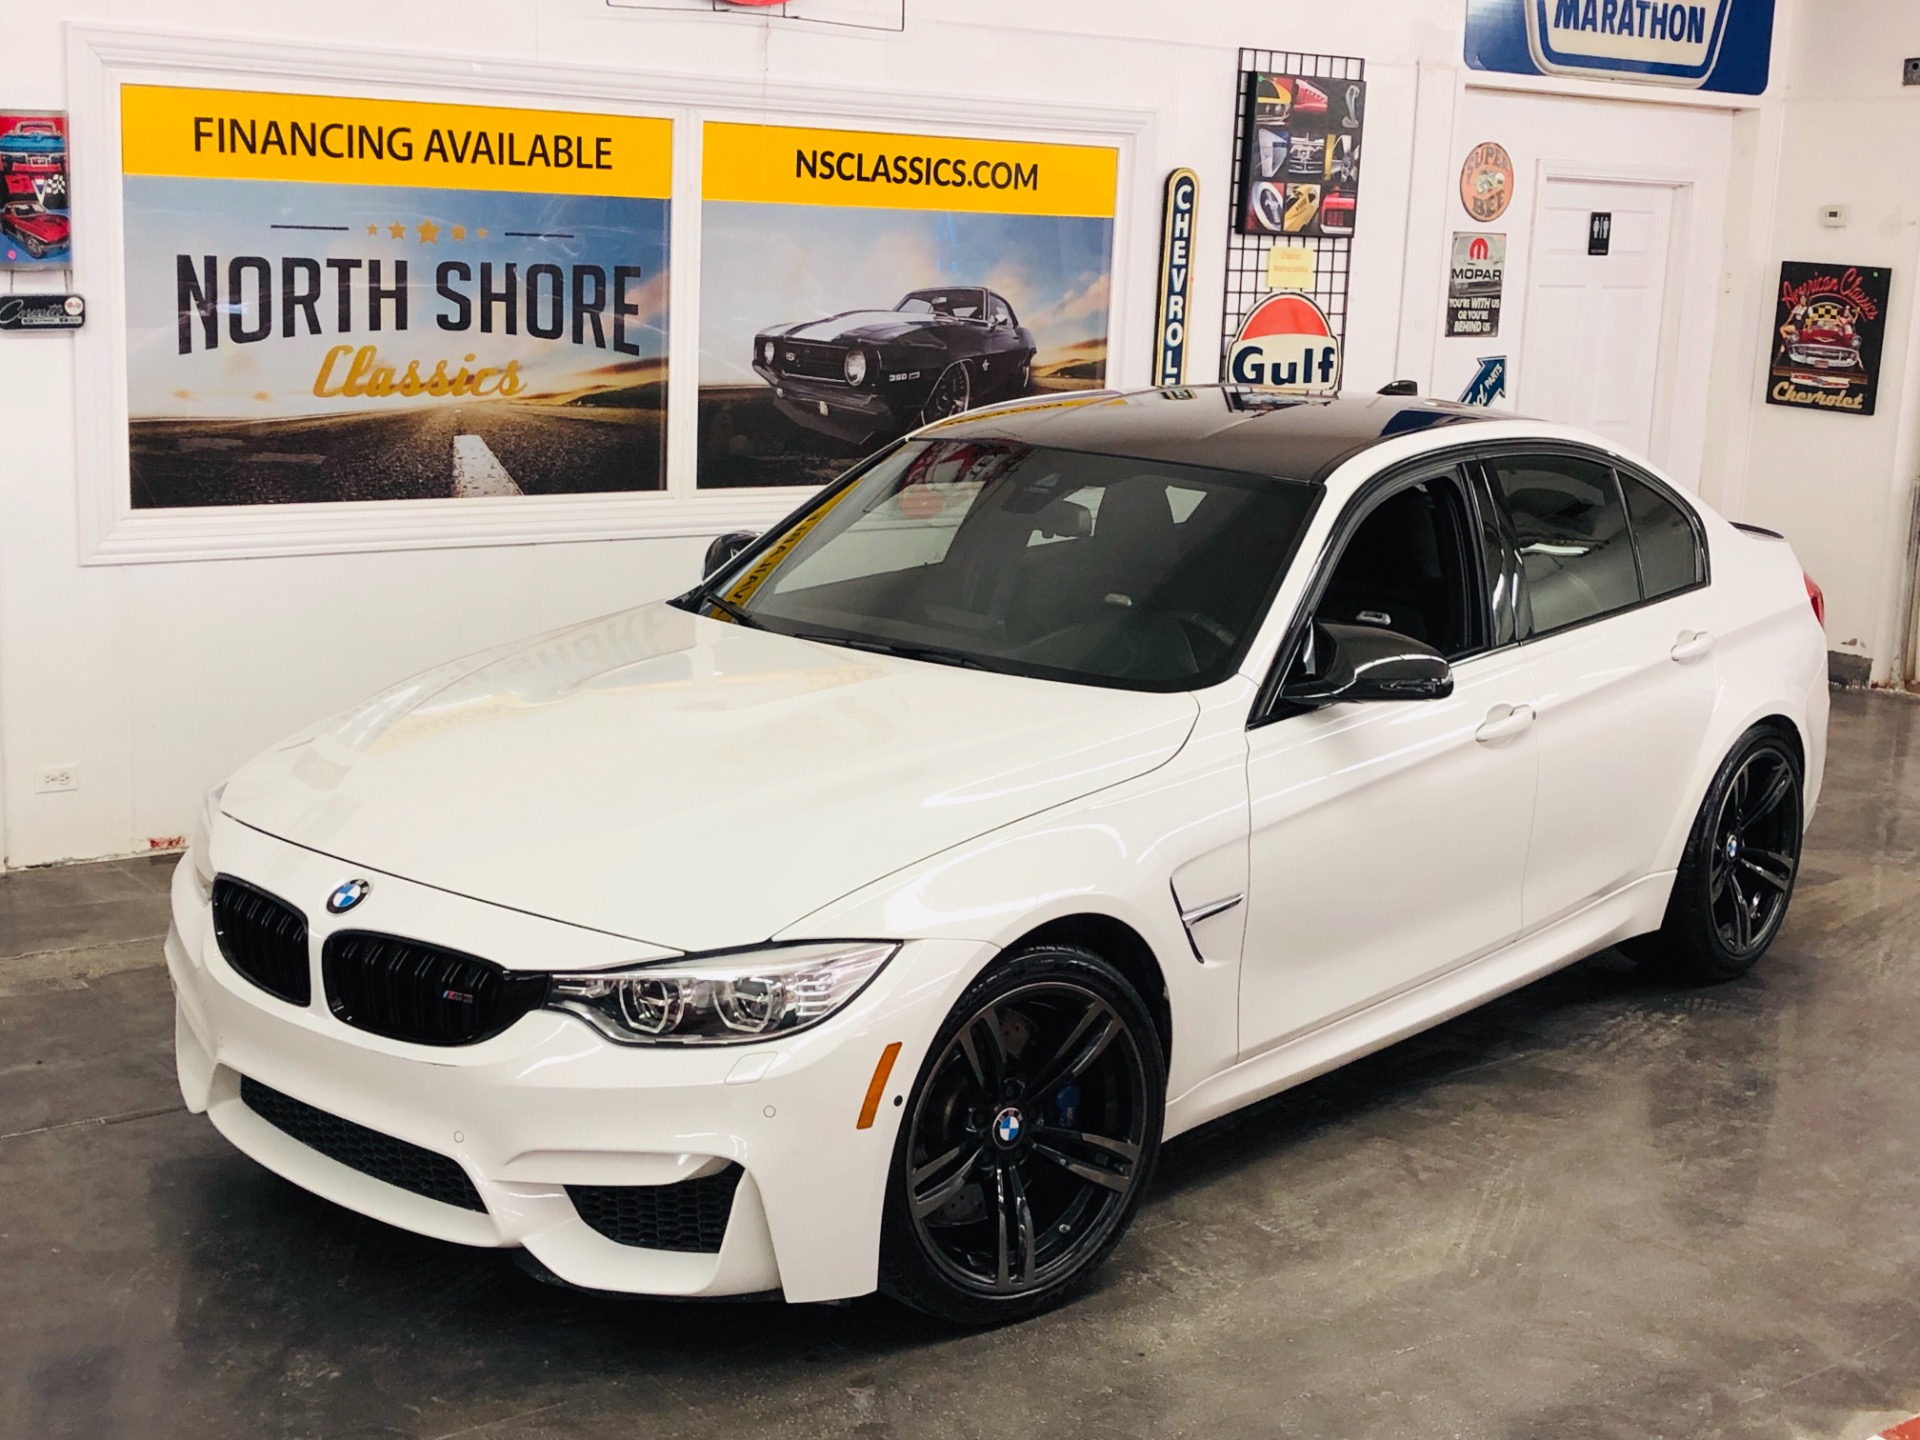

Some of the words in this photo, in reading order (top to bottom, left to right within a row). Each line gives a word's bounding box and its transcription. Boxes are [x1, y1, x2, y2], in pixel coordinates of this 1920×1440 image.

[1553, 0, 1706, 44] MARATHON
[193, 116, 414, 161] FINANCING
[423, 129, 613, 170] AVAILABLE
[796, 148, 1039, 191] NSCLASSICS.COM
[1466, 146, 1509, 186] SUPER
[1472, 189, 1505, 218] BEE
[1164, 184, 1193, 385] CHEVROL
[1451, 268, 1502, 280] MOPAR
[1782, 275, 1840, 310] American
[176, 254, 409, 356] NORTH
[436, 260, 641, 357] SHORE
[1458, 310, 1468, 320] OR
[1471, 297, 1491, 310] WITH
[1491, 298, 1501, 309] US
[1454, 321, 1482, 333] BEHIND
[1482, 322, 1491, 333] US
[312, 344, 528, 398] Classics
[1232, 345, 1336, 386] Gulf
[1484, 363, 1503, 390] PARTS
[1772, 381, 1864, 410] Chevrolet
